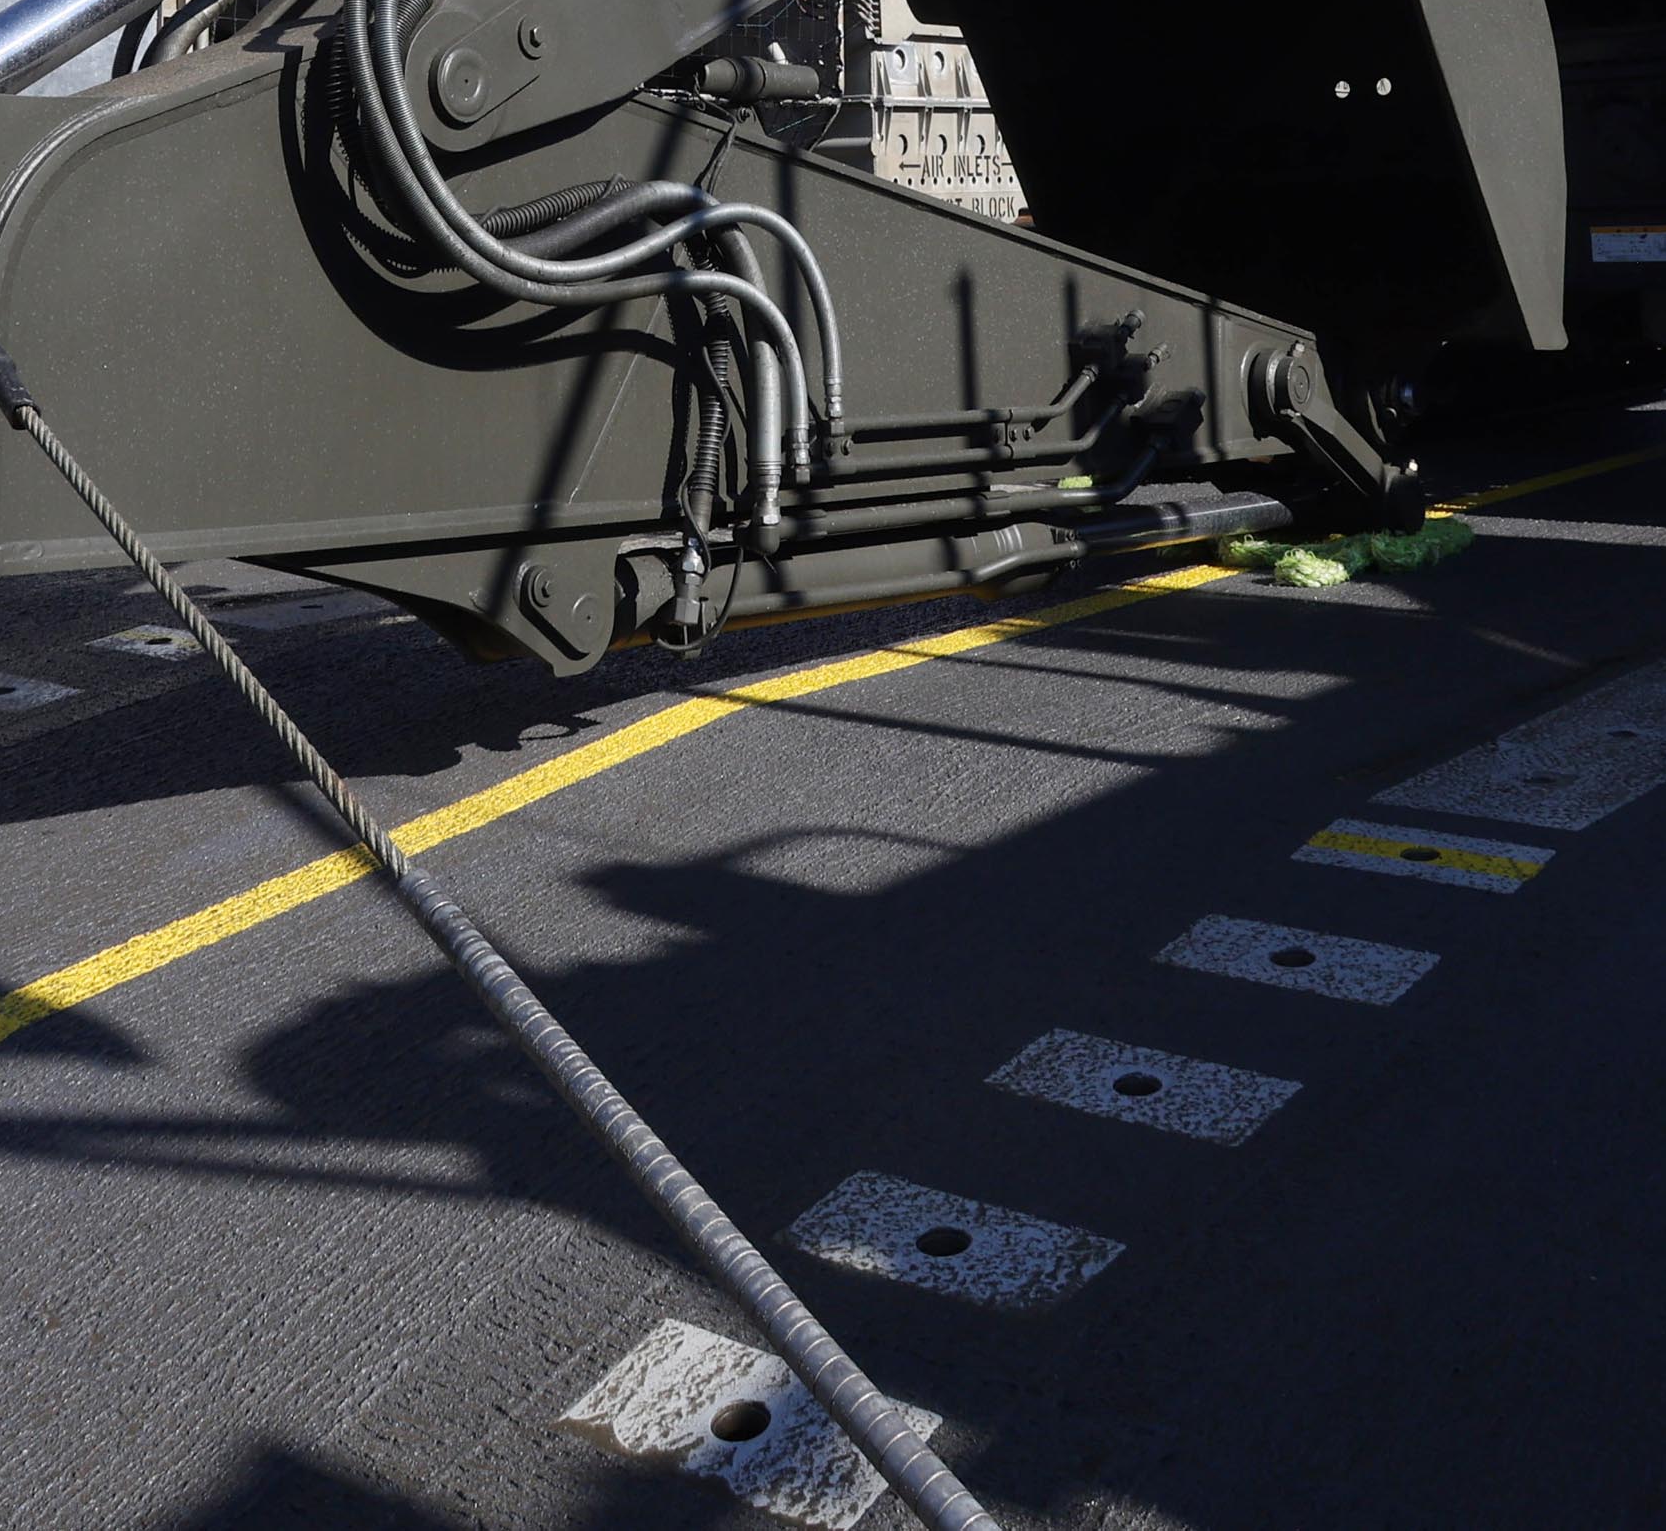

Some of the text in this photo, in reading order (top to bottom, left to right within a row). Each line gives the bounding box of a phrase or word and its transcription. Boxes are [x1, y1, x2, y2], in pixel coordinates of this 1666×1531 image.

[922, 154, 1002, 177] AIR INLETS
[972, 197, 1017, 218] BLOCK
